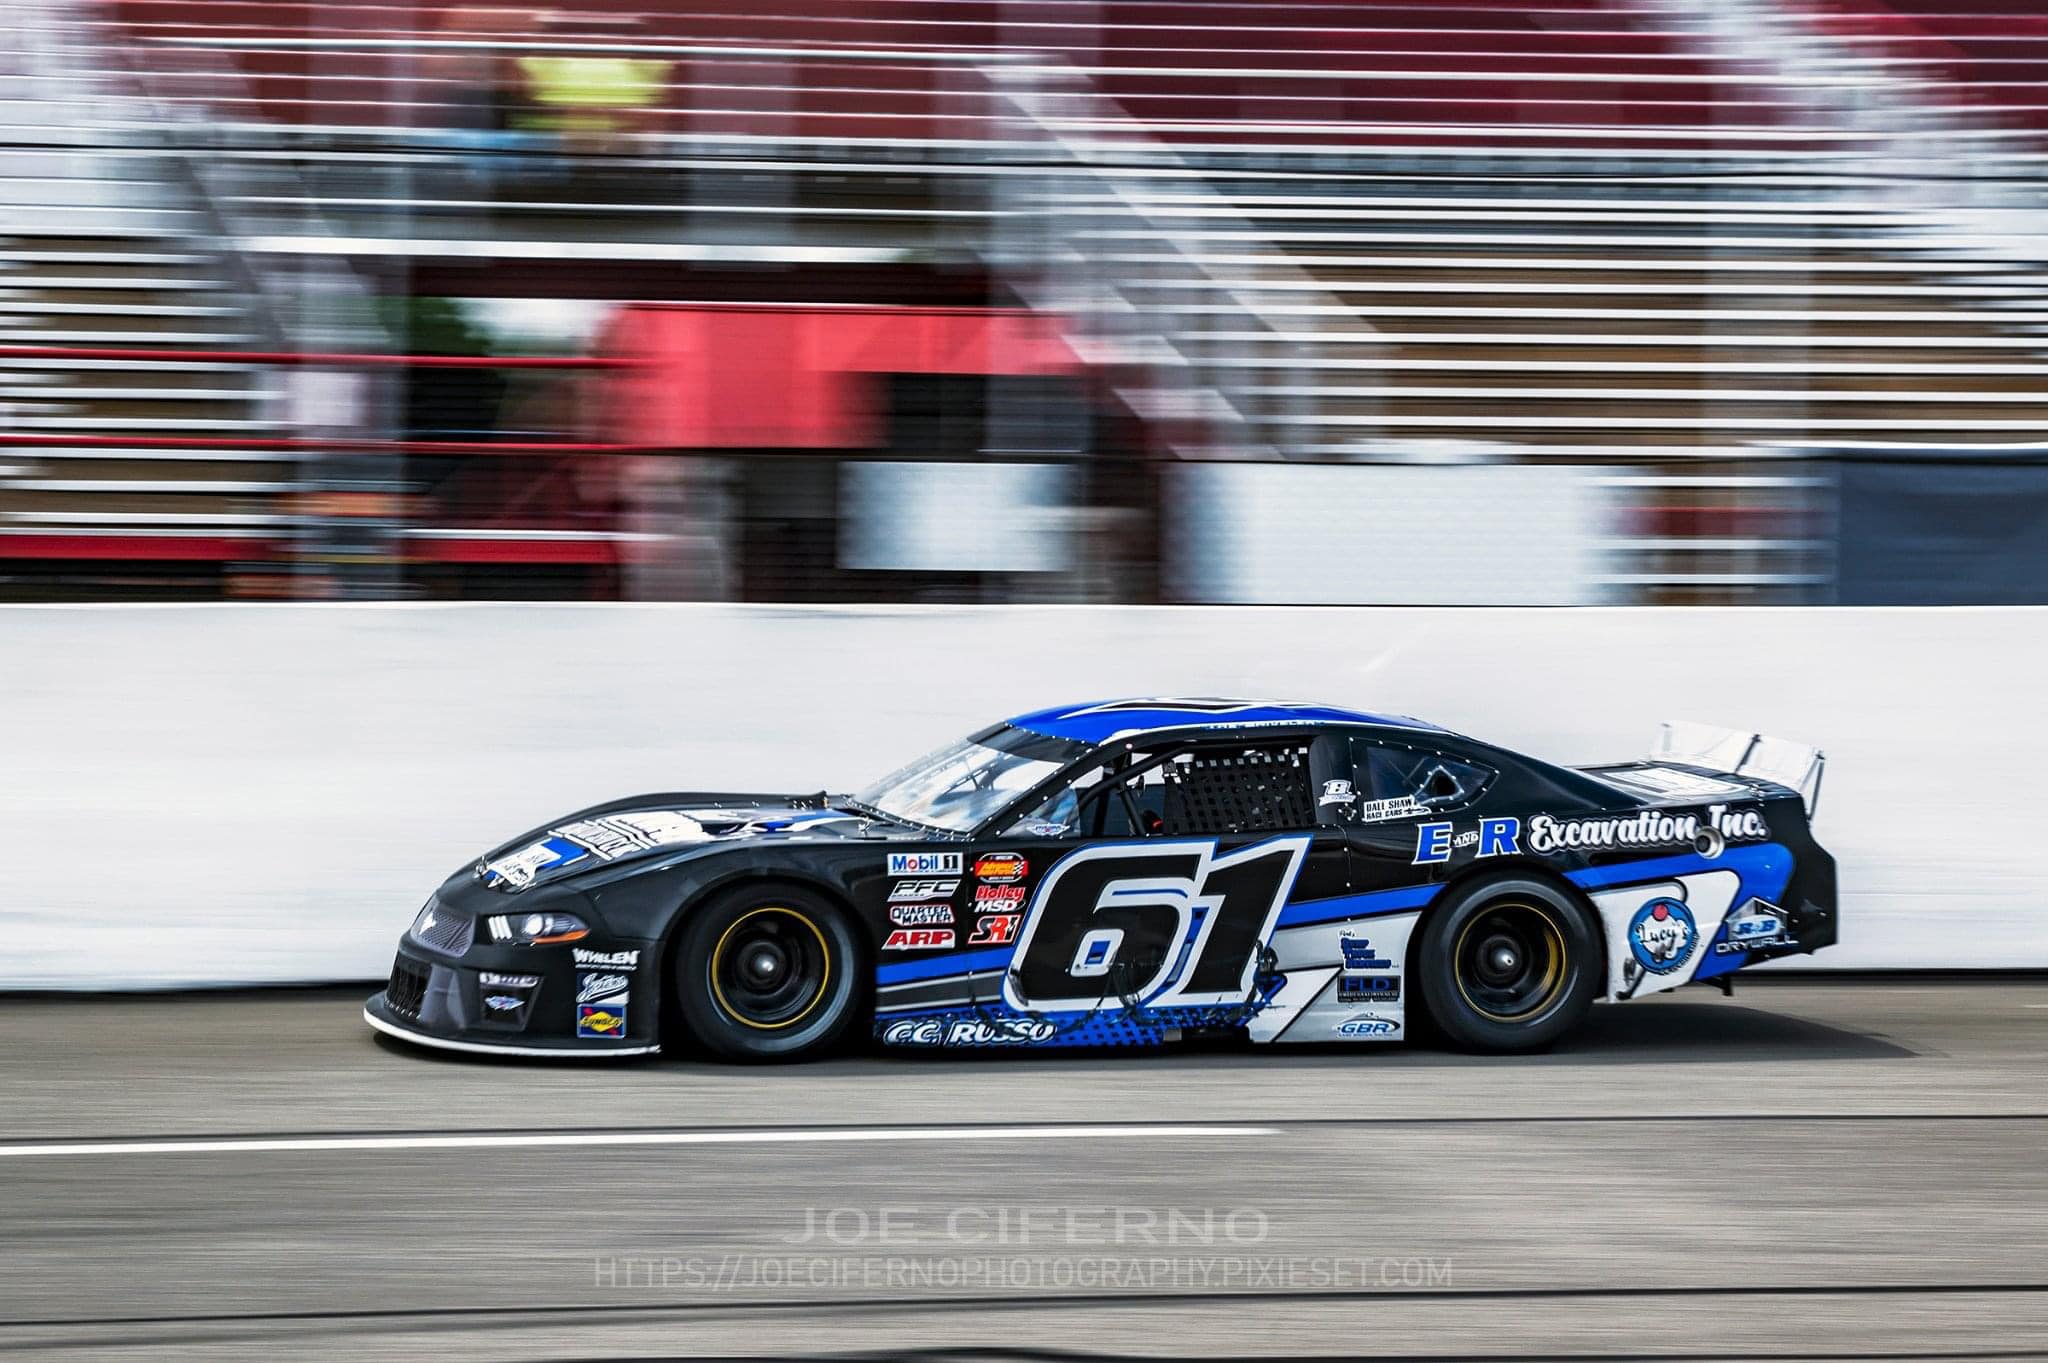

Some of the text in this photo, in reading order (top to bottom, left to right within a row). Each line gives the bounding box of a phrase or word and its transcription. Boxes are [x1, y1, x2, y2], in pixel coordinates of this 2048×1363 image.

[1388, 798, 1413, 809] SHAW
[1412, 804, 1767, 865] E AND R Excavation Inc.
[892, 854, 959, 870] Mobil 1
[894, 881, 960, 894] PFC
[975, 884, 1026, 903] Holley
[892, 906, 949, 919] QUARTER
[974, 899, 1018, 913] MSD
[902, 913, 952, 924] MASTER
[1002, 834, 1313, 1012] 61
[886, 931, 954, 945] ARP
[1635, 922, 1690, 952] Lucy's
[571, 947, 641, 965] WHELEN
[947, 1019, 1057, 1045] RUSSO
[1341, 1023, 1390, 1033] GBR
